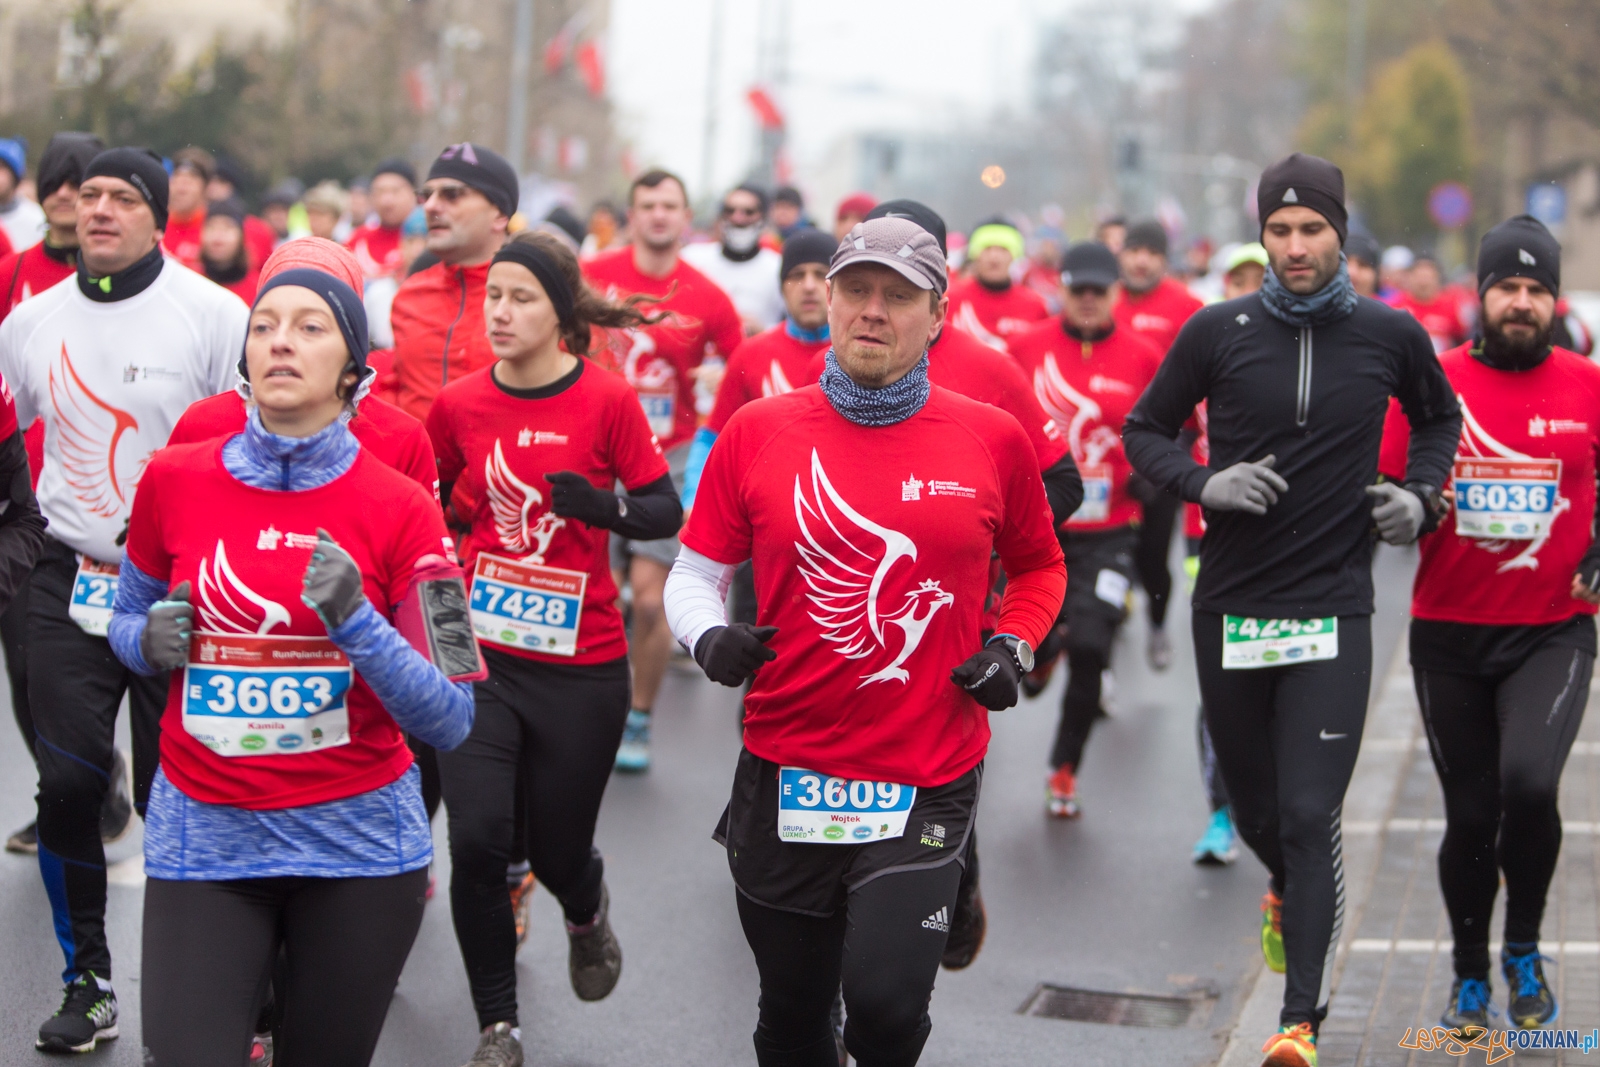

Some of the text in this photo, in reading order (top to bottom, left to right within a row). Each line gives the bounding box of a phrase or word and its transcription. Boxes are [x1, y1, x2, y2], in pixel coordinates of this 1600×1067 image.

[927, 479, 937, 496] 1
[1466, 484, 1549, 513] 6036
[485, 584, 567, 626] 7428
[272, 650, 341, 660] RunPoland.org
[189, 674, 333, 716] E 3663
[247, 722, 286, 730] Kamila
[783, 775, 901, 809] E 3609
[830, 814, 861, 824] Wojtek
[782, 825, 804, 833] GRUPA
[920, 837, 944, 848] RUN
[921, 919, 950, 933] adidas
